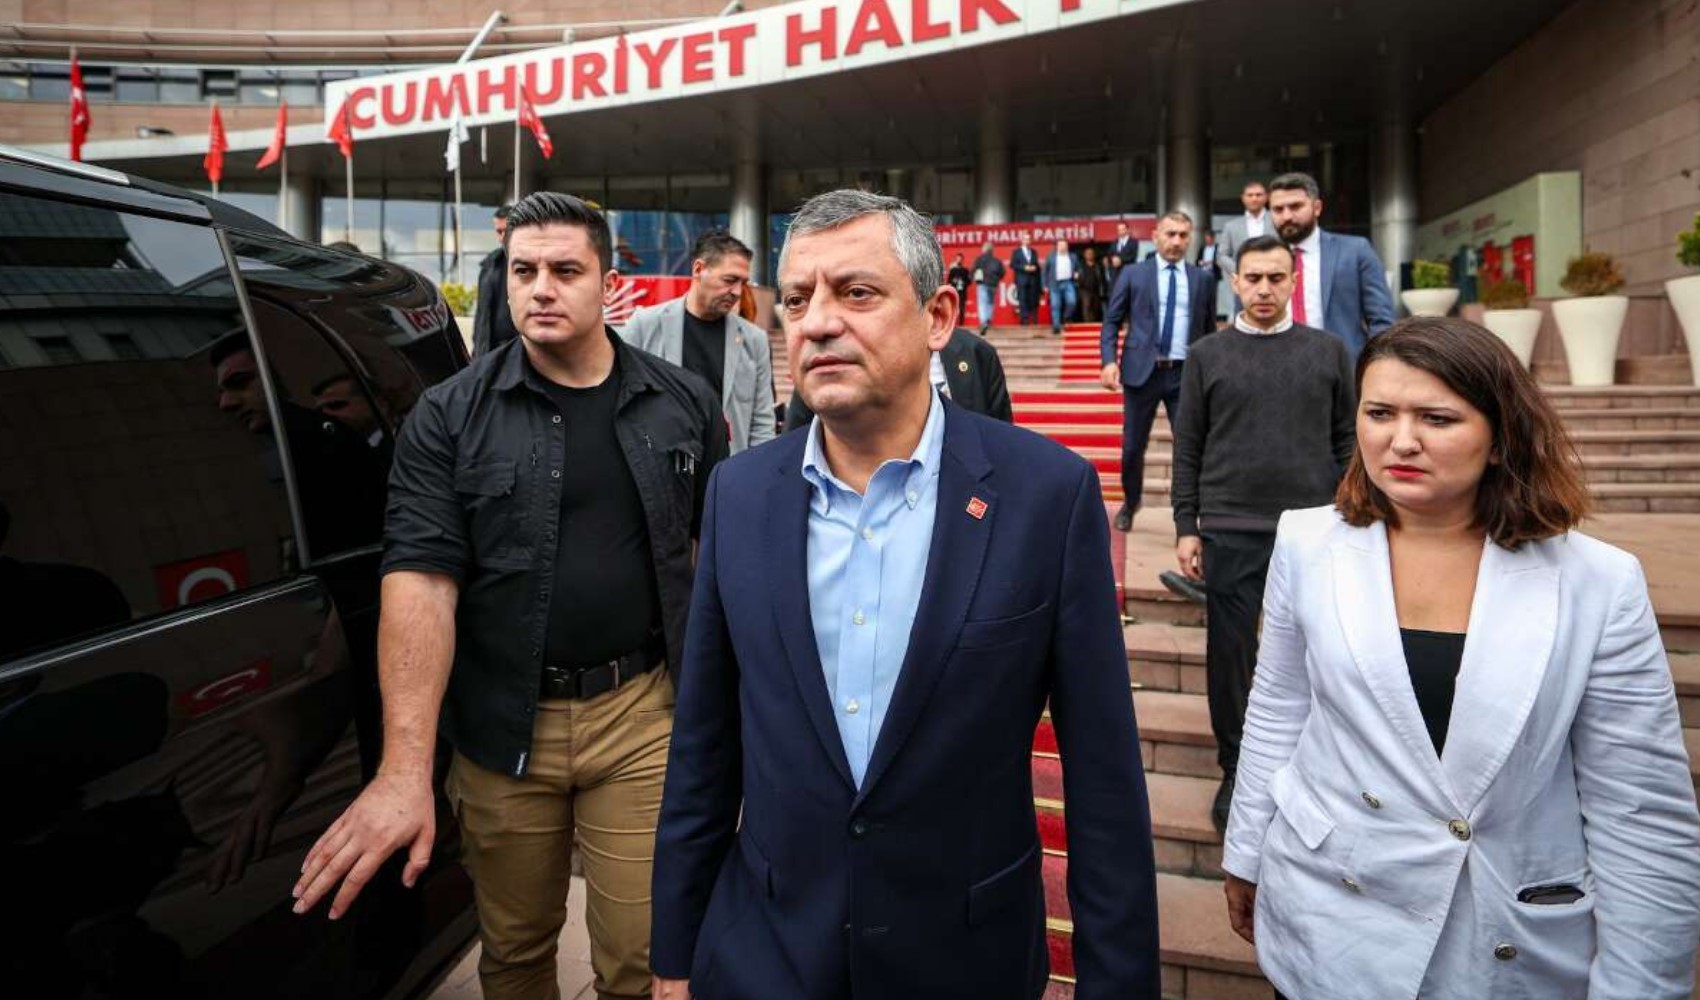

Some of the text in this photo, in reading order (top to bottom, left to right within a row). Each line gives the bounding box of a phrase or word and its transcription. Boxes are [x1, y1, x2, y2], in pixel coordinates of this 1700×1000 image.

[346, 0, 1021, 129] CUMHURİYET HALK
[1033, 223, 1095, 241] PARTİSİ
